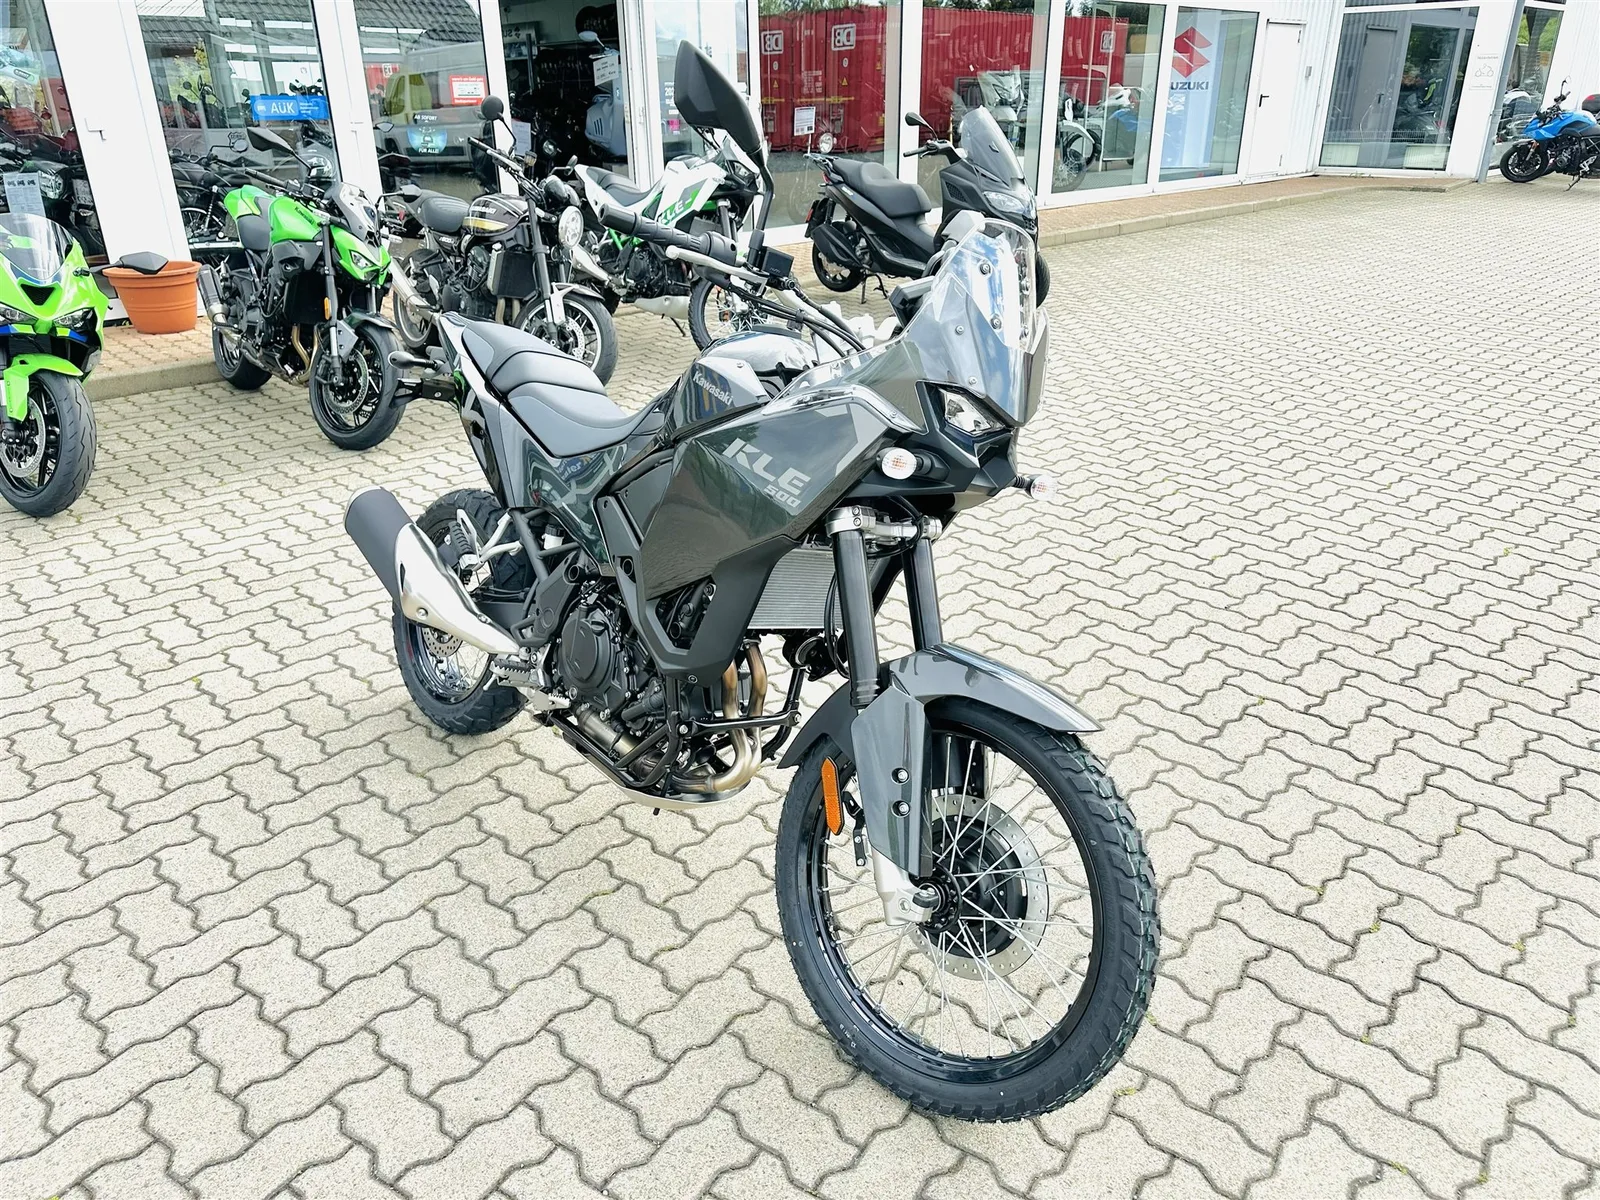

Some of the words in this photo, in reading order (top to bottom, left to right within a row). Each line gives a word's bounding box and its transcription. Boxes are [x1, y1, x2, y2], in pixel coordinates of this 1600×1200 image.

[1171, 81, 1209, 91] UZUKI
[271, 101, 295, 114] AÜK
[692, 371, 734, 406] Kawasaki
[722, 437, 811, 496] KLE
[763, 485, 802, 508] 500
